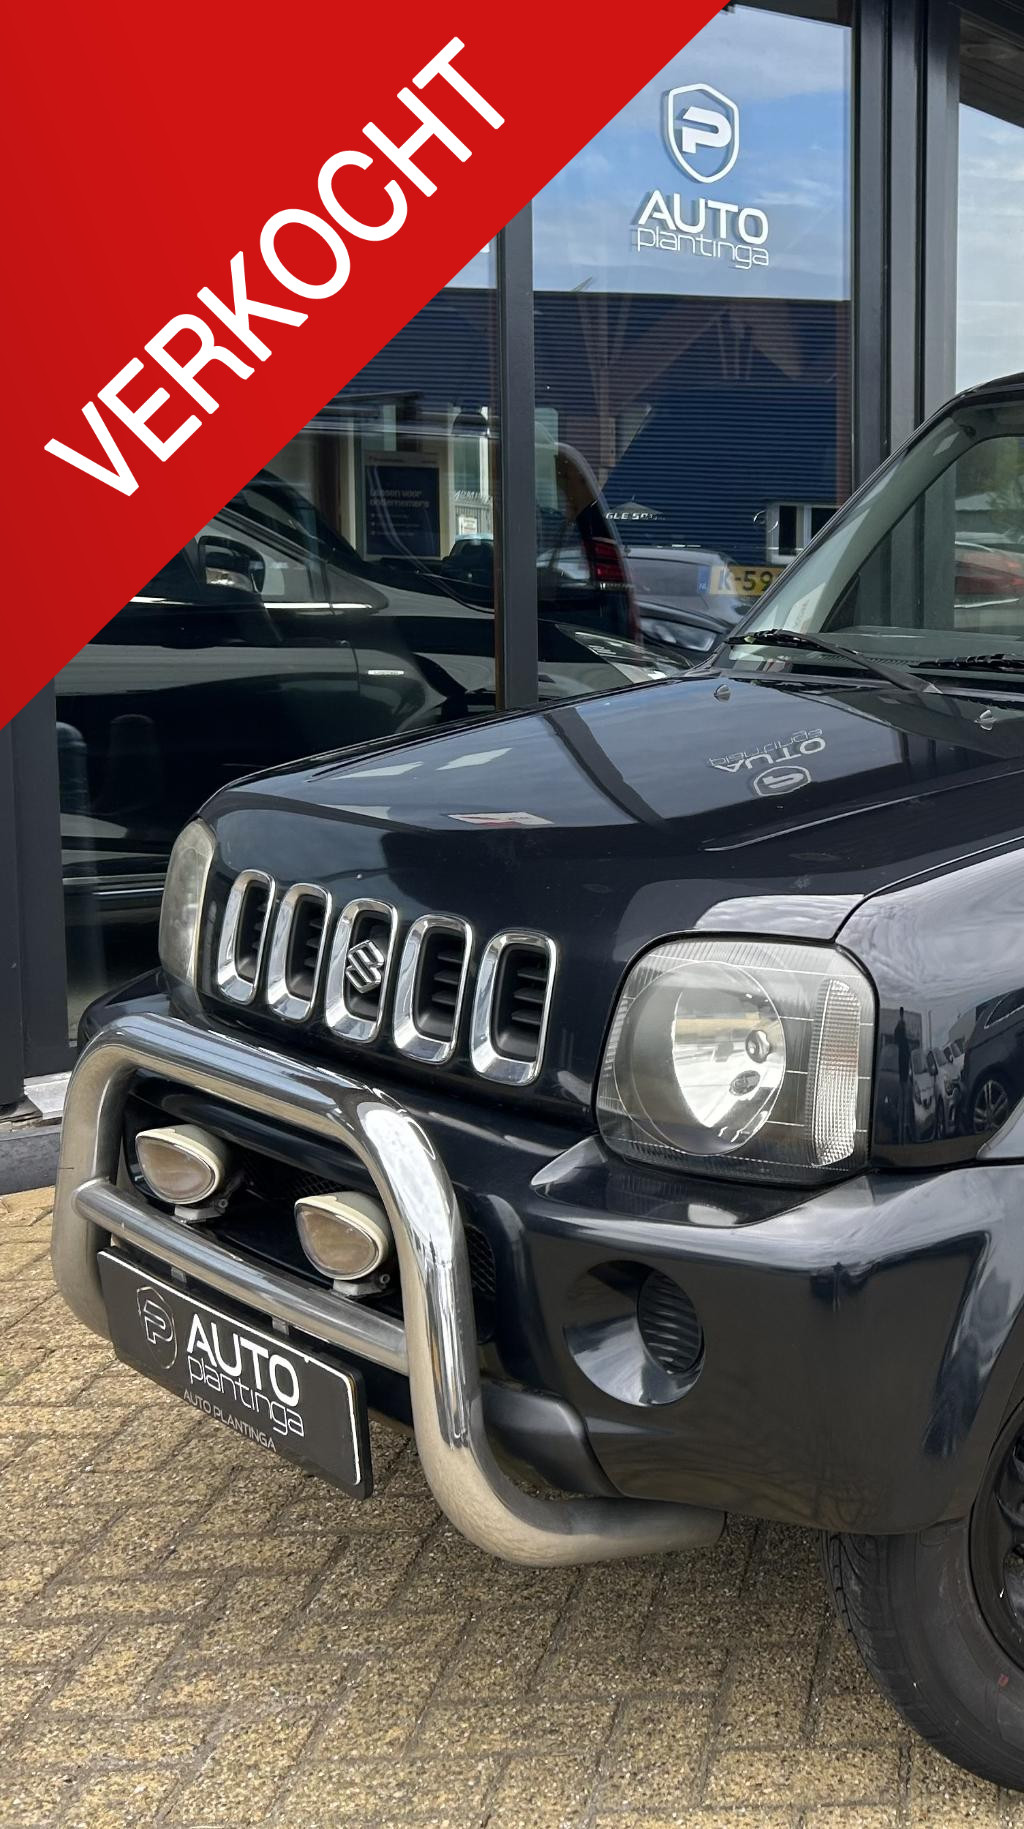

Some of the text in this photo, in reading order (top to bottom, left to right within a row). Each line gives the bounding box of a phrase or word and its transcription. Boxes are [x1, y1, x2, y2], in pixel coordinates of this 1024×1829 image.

[638, 190, 769, 245] AUTO
[637, 226, 769, 270] plantinga
[606, 512, 629, 520] GLE
[187, 1313, 300, 1407] AUTO
[183, 1389, 277, 1452] AUTO PLANTINGA
[187, 1355, 304, 1437] plantinga
